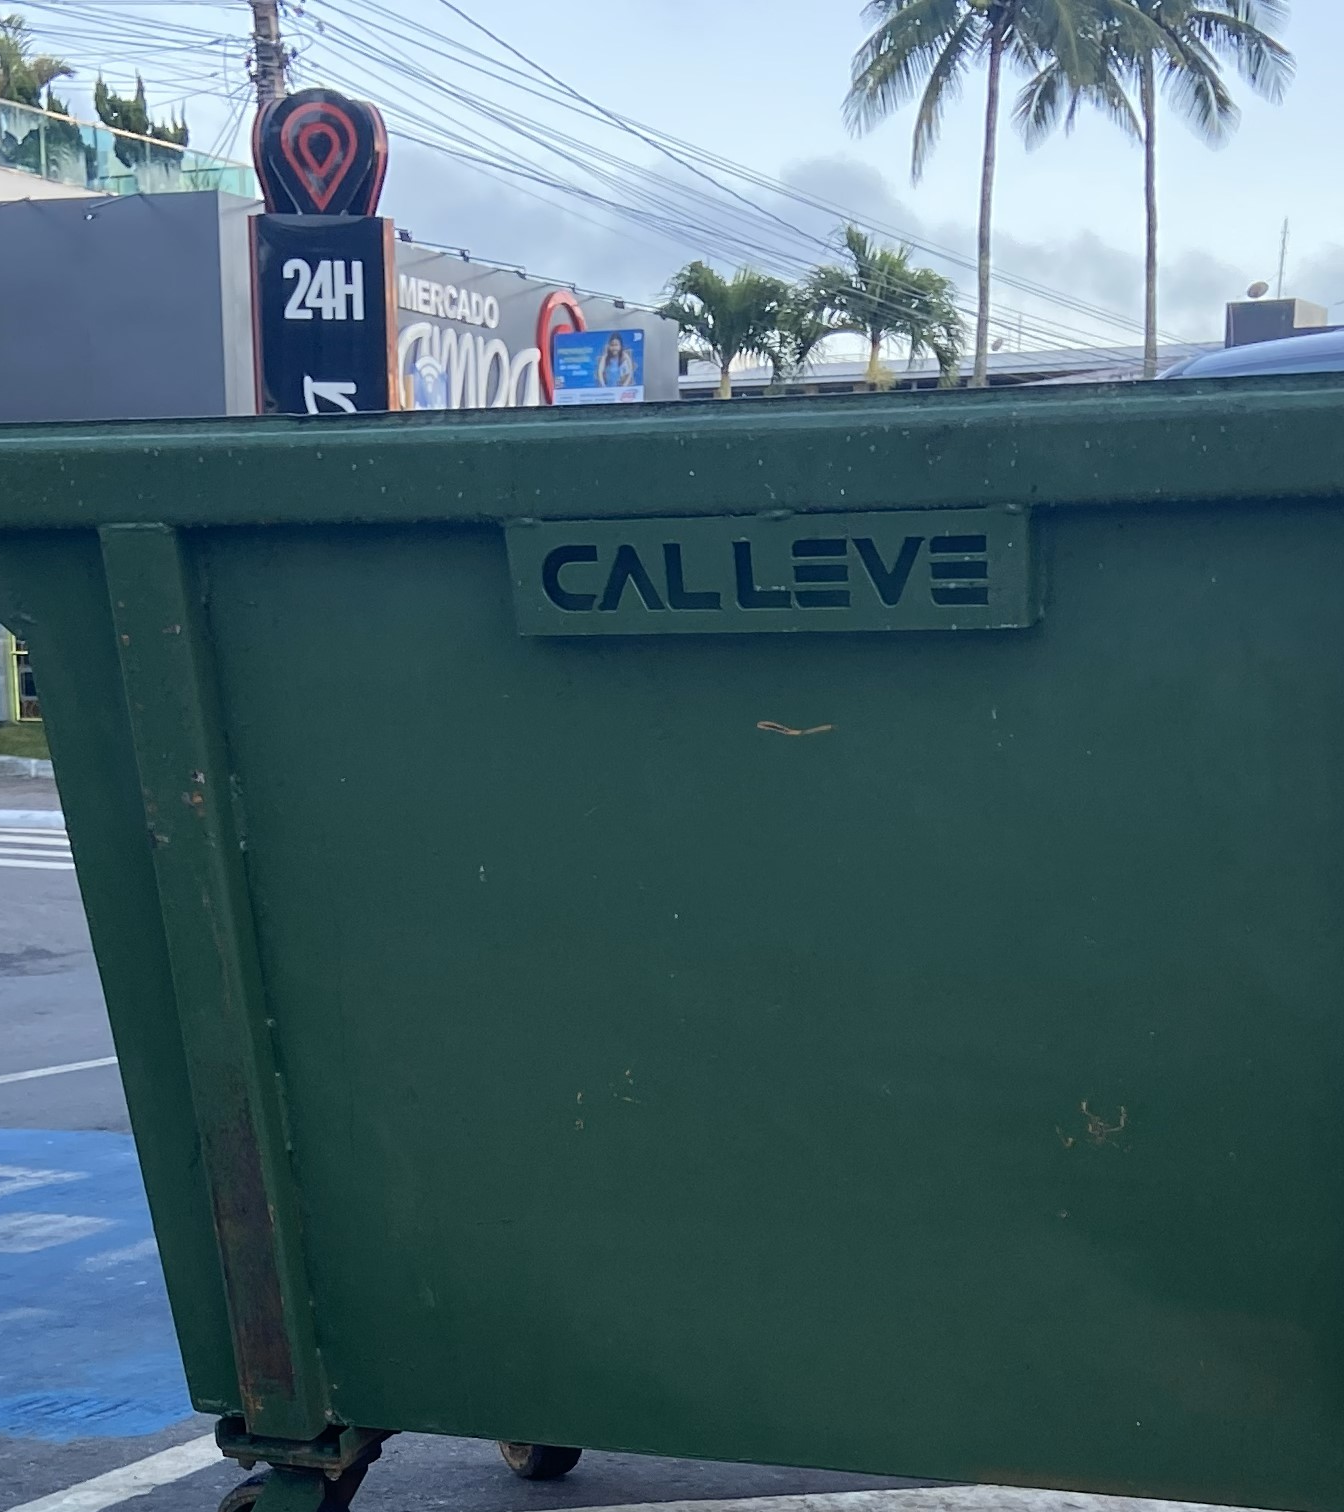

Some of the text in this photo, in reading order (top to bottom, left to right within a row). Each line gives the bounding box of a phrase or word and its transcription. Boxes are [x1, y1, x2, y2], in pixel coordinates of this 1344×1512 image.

[283, 258, 365, 321] 24H
[398, 273, 499, 329] MERCADO
[398, 321, 541, 409] ampa
